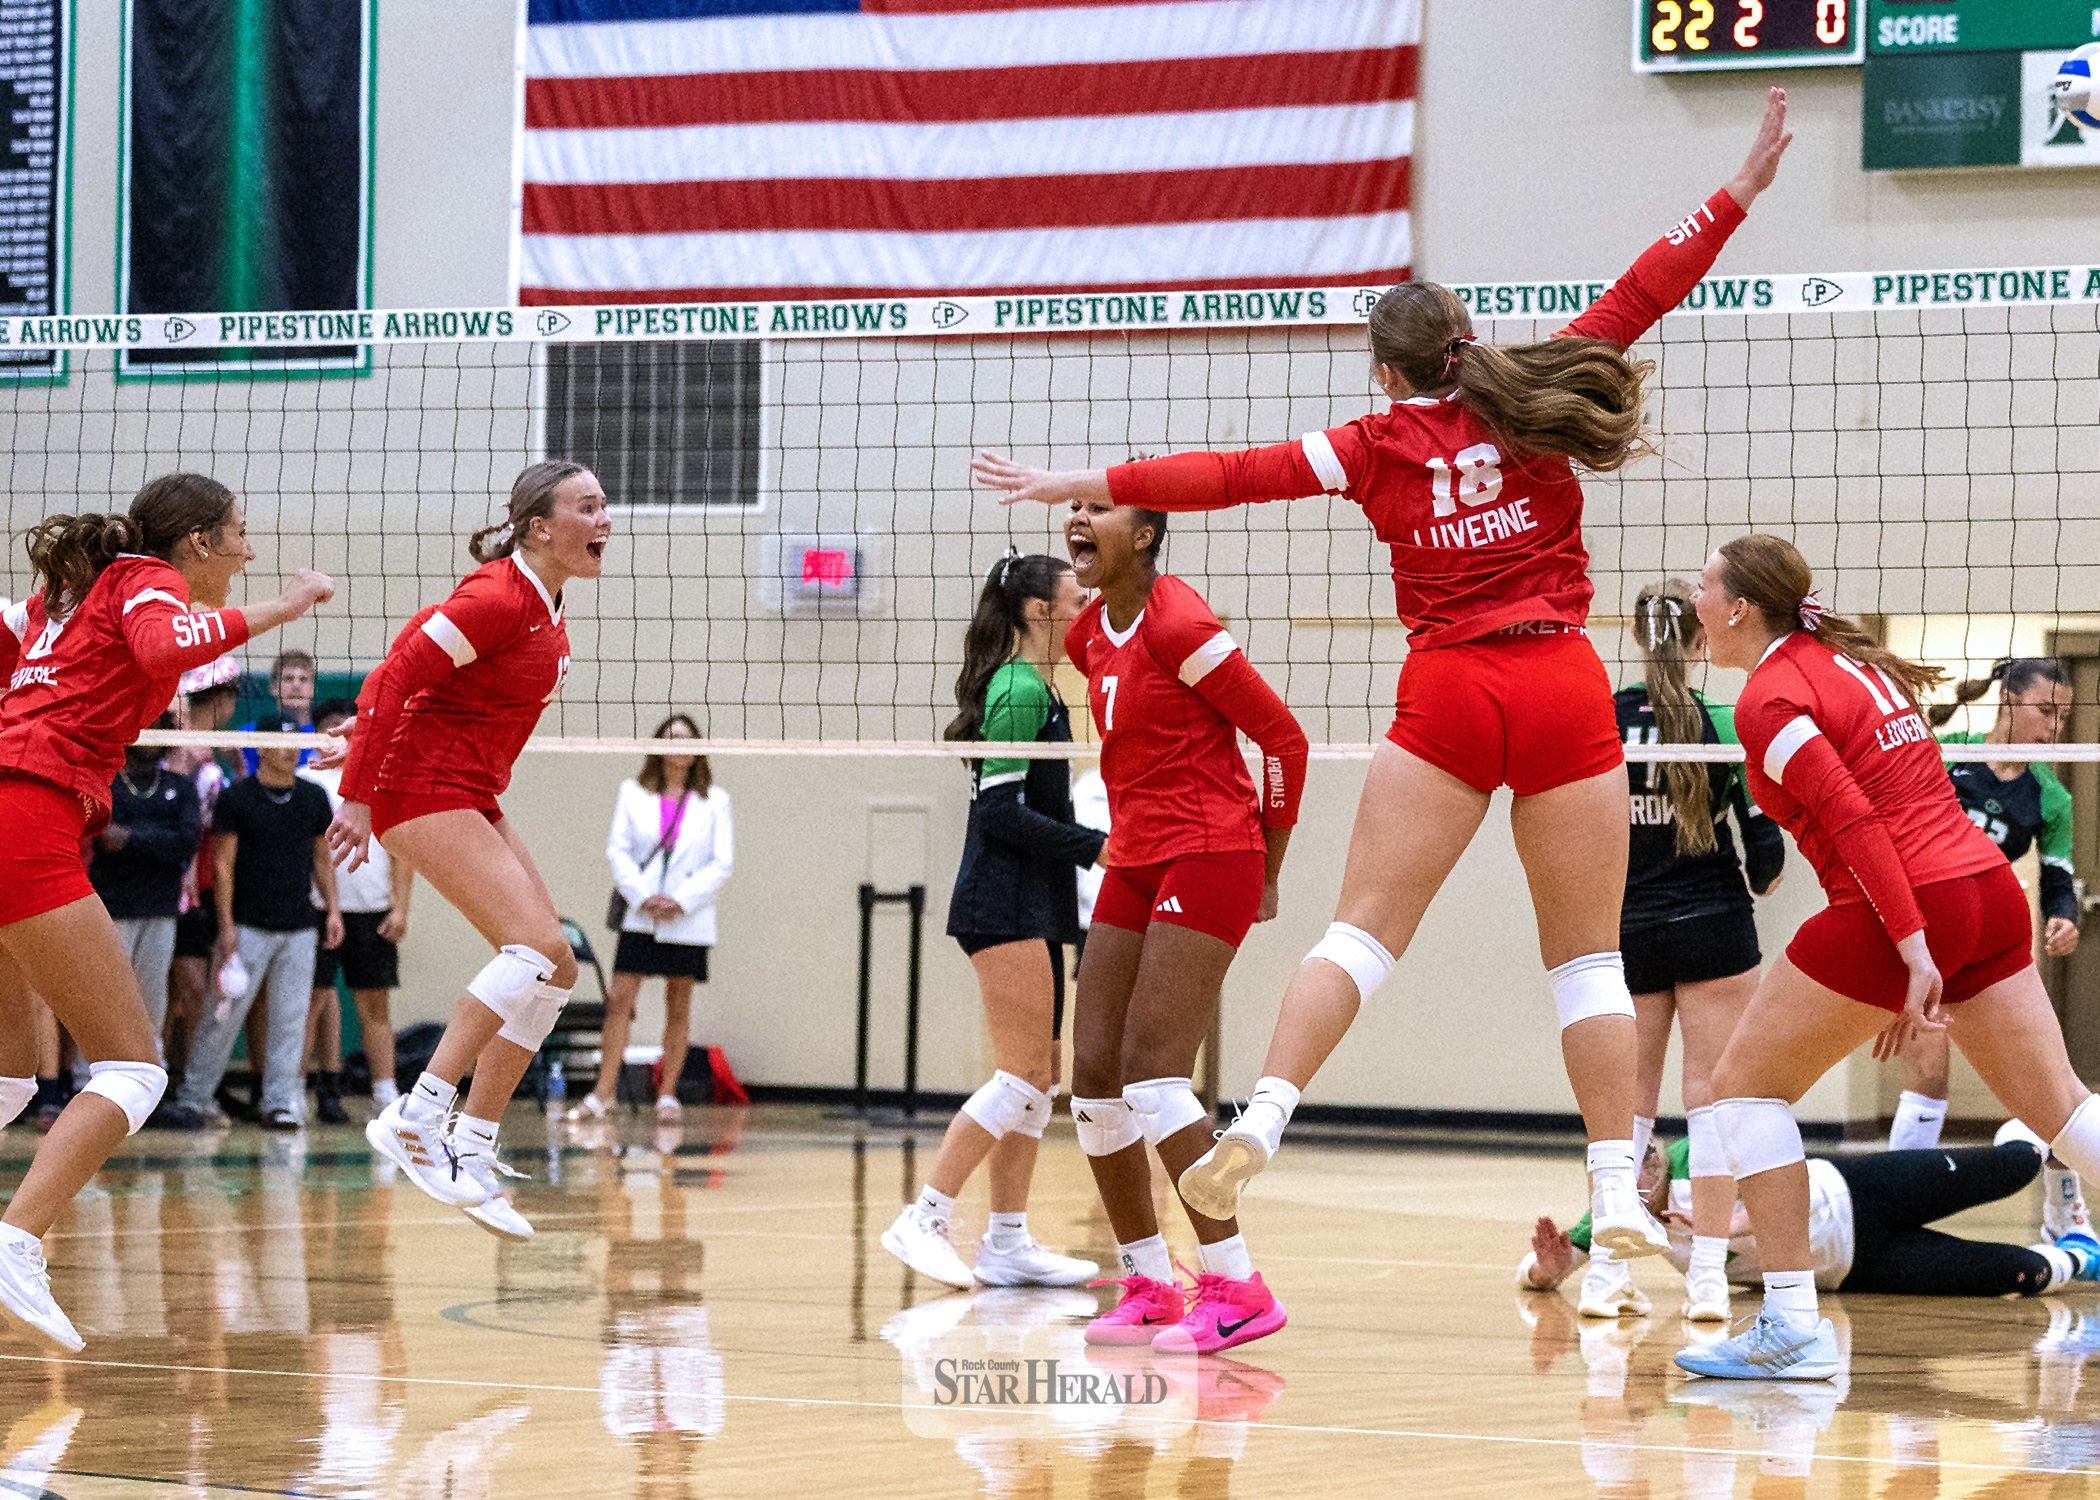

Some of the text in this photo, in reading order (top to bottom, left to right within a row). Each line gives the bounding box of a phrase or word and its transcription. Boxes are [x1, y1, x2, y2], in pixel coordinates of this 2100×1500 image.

[1652, 0, 1846, 51] 22 2 0
[1878, 13, 1959, 46] SCORE
[1454, 283, 1605, 313] PESTONE
[1872, 269, 2071, 304] PIPESTONE
[219, 311, 514, 341] PIPESTONE ARROWS
[595, 303, 908, 335] PIPESTONE ARROWS
[995, 290, 1327, 327] PIPESTONE ARROWS
[19, 318, 142, 343] ARROWS
[1425, 442, 1503, 518] 18
[1101, 676, 1118, 730] 7
[1875, 713, 1928, 752] LUVER
